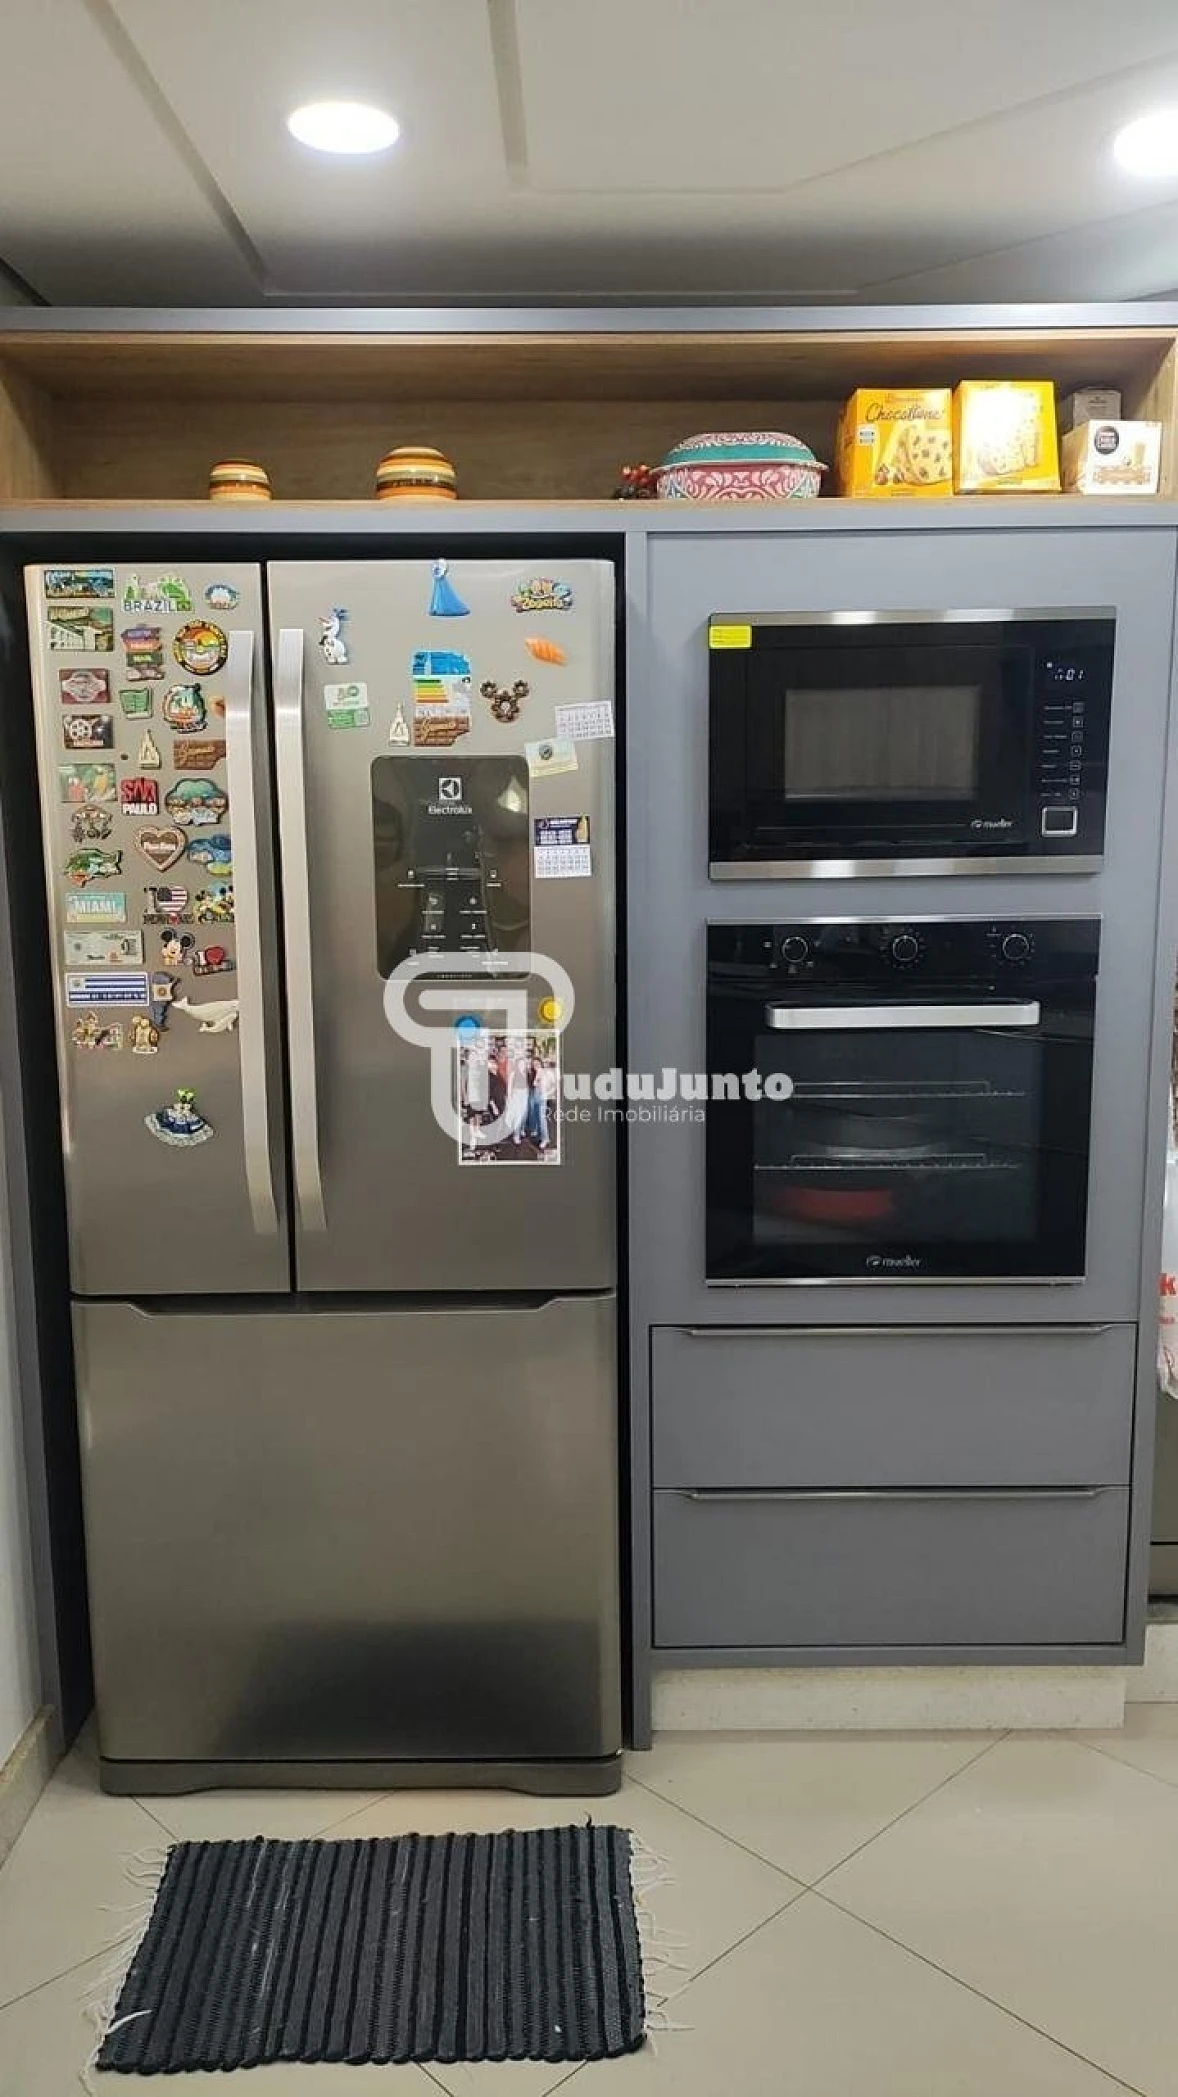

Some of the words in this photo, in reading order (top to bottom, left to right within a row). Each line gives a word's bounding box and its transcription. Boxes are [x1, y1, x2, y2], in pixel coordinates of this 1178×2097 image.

[124, 601, 176, 612] BRAZIL
[122, 803, 158, 816] PAULO
[428, 805, 473, 815] Electrolux
